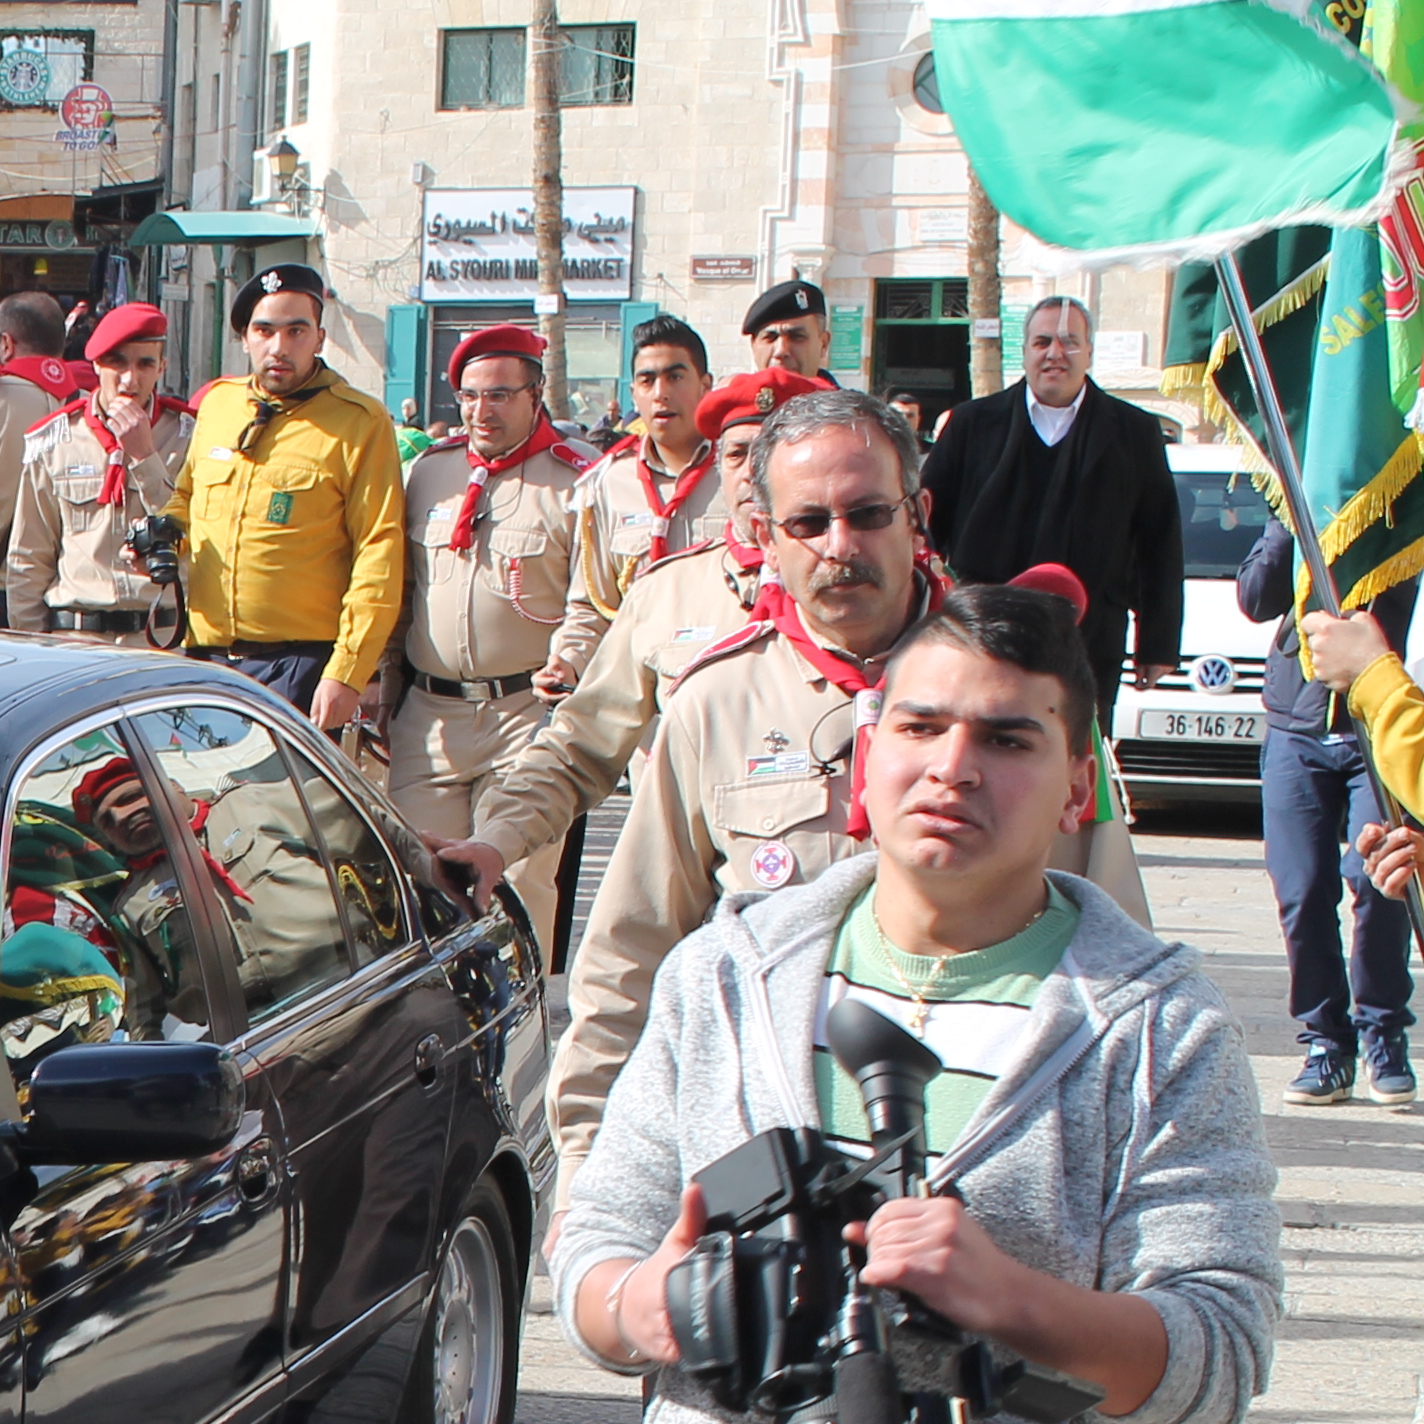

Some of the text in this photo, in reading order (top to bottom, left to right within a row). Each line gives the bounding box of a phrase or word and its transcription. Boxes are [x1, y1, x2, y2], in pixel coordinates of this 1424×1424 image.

[427, 210, 507, 245] السيوري
[449, 259, 509, 280] SYOURI
[1320, 281, 1385, 355] SALE
